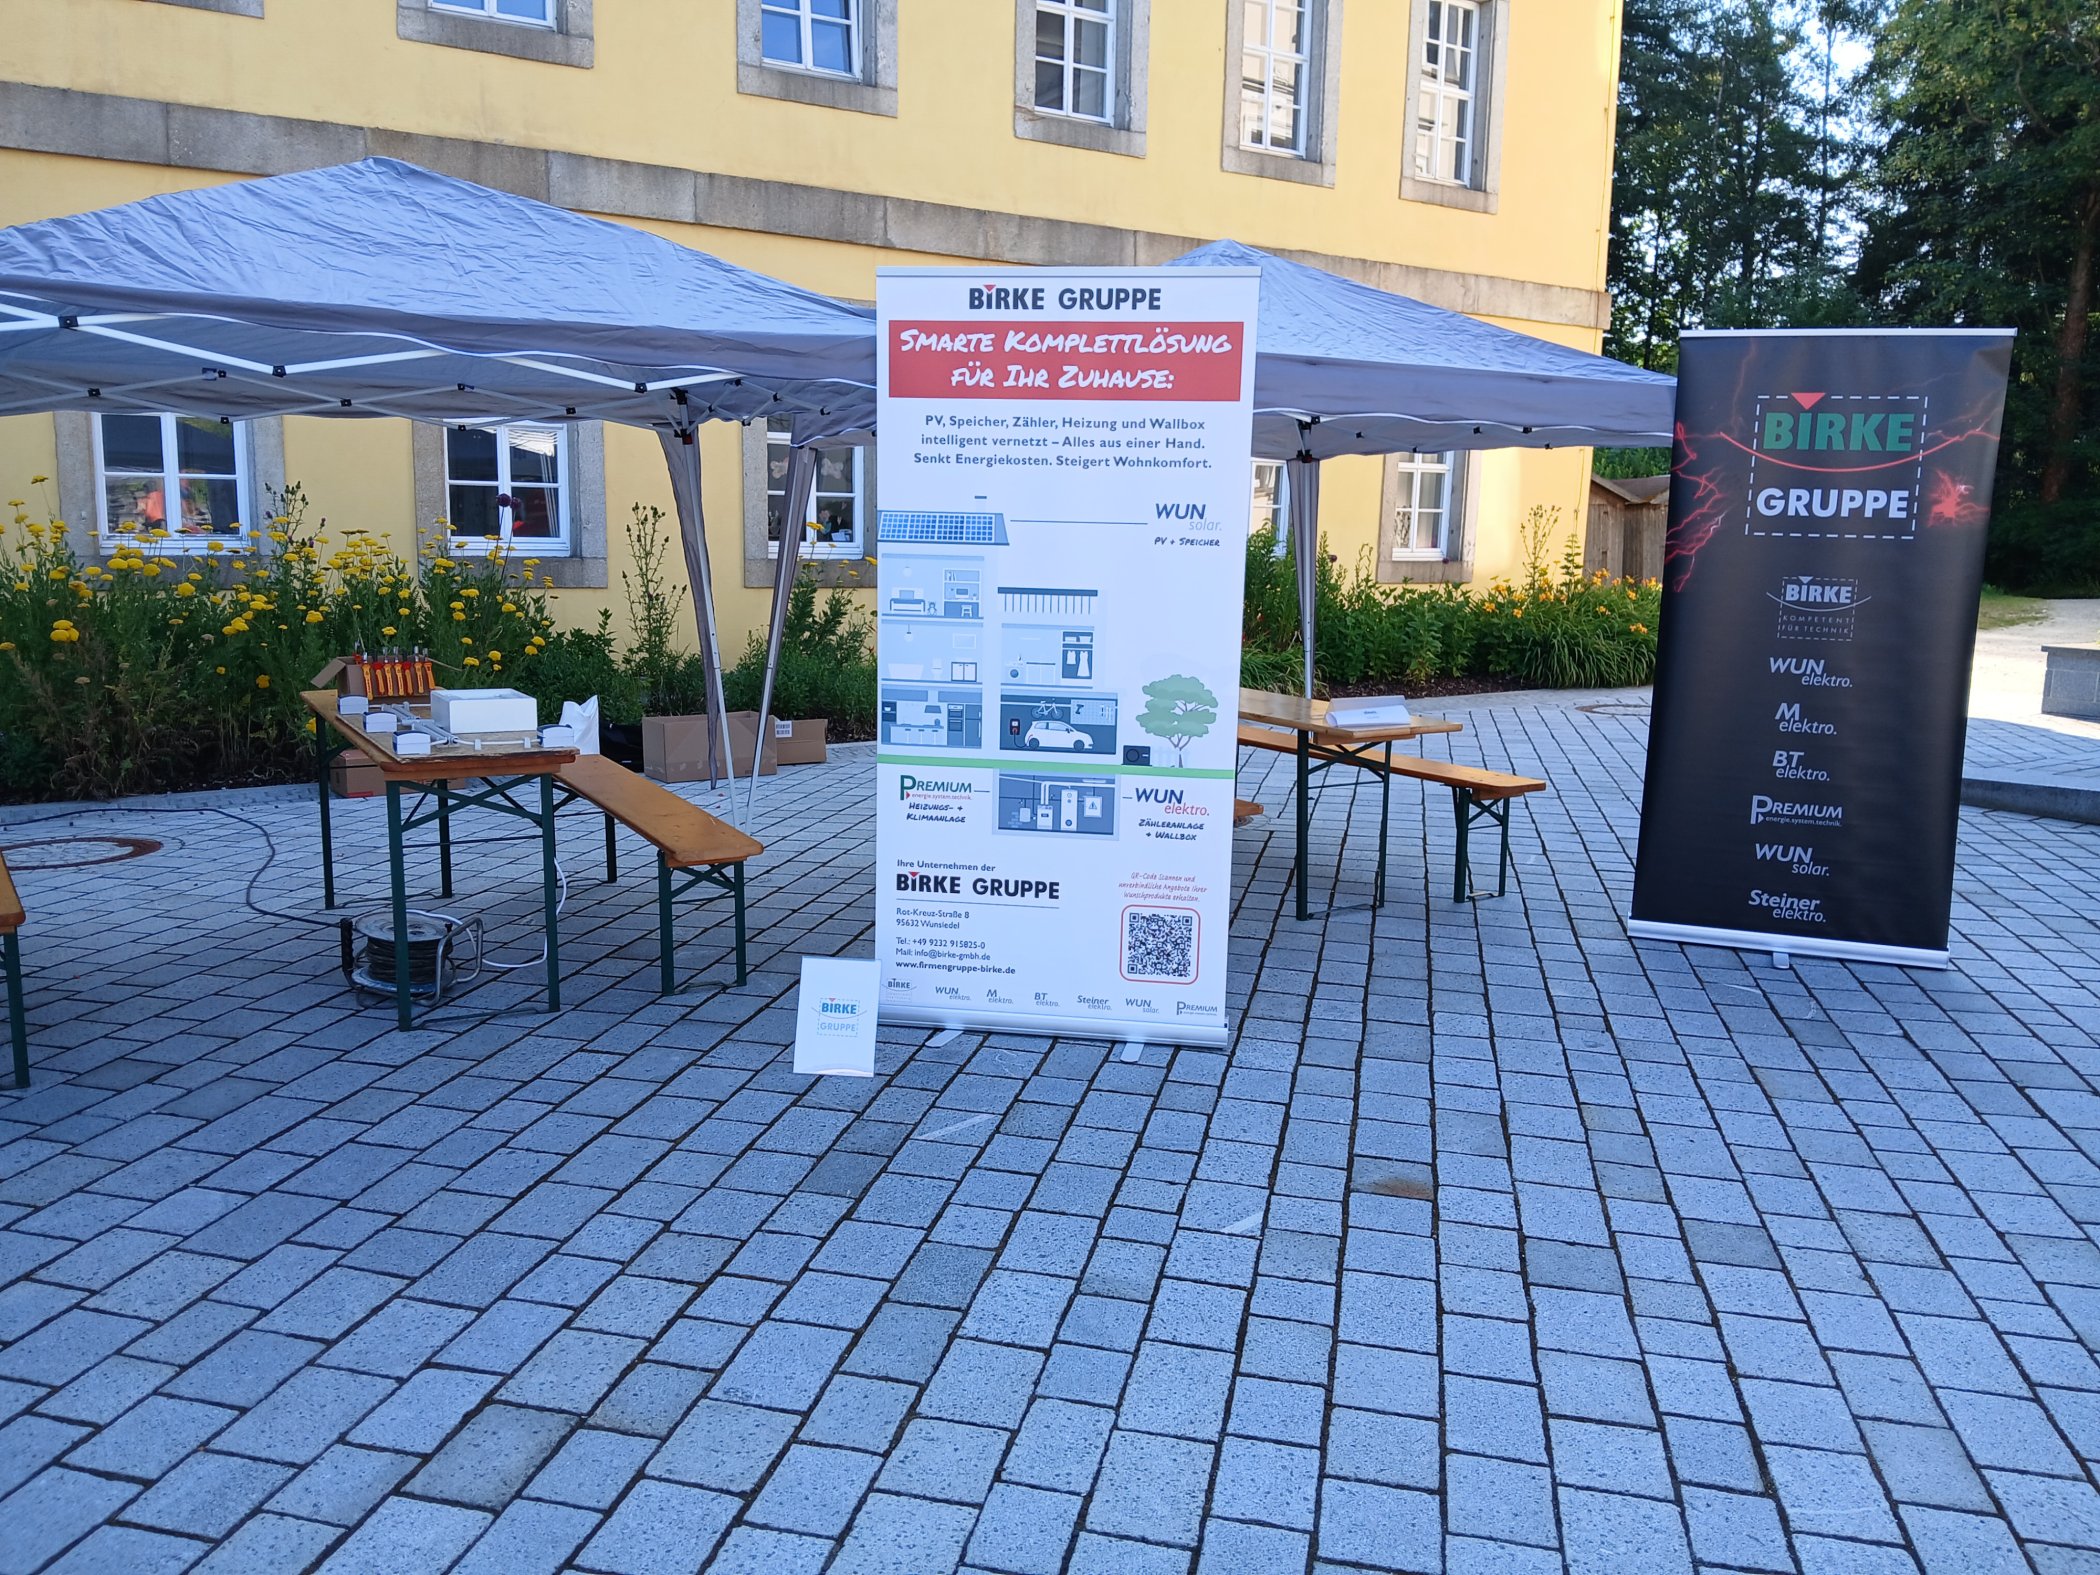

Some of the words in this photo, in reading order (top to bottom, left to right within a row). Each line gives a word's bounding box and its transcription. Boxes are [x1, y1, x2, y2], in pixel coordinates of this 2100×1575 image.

[969, 286, 1045, 310] BIRKE
[1058, 287, 1162, 310] GRUPPE
[925, 415, 946, 428] PV,
[949, 415, 1009, 430] Speicher,
[1012, 415, 1059, 429] Zähler,
[1062, 416, 1117, 431] Heizung
[1122, 418, 1146, 430] und
[1150, 418, 1205, 430] Wallbox
[1763, 412, 1915, 451] BIRKE
[921, 434, 987, 448] intelligent
[992, 436, 1048, 447] vernetzt
[1062, 436, 1095, 448] Alles
[1100, 439, 1121, 449] aus
[1126, 437, 1160, 449] einer
[1166, 437, 1205, 449] Hand.
[914, 452, 951, 464] Senkt
[955, 453, 1052, 467] Energiekosten.
[1056, 455, 1110, 469] Steigert
[1113, 455, 1212, 469] Wohnkomfort.
[1756, 487, 1909, 518] GRUPPE
[1155, 503, 1206, 520] WUN
[1189, 517, 1222, 531] solar.
[1154, 537, 1167, 545] PV
[1785, 584, 1852, 603] BIRKE
[1782, 615, 1850, 623] KOMPETENT
[1804, 626, 1849, 634] TECHNIK
[1769, 657, 1825, 675] WUN
[1801, 672, 1853, 688] elektro.
[1775, 702, 1800, 721] M
[1779, 718, 1837, 735] elektro.
[1772, 750, 1804, 767] BT
[1776, 765, 1830, 781] elektro.
[1135, 787, 1184, 804] WUN
[1164, 802, 1210, 816] elektro.
[1755, 843, 1813, 863] WUN
[896, 859, 915, 868] Ihre
[917, 860, 978, 871] Unternehmen
[981, 863, 996, 872] der
[1792, 861, 1830, 876] solar.
[896, 873, 961, 894] BIRKE
[972, 877, 1060, 900] GRUPPE
[1748, 889, 1820, 911] Steiner
[896, 908, 962, 919] Rot-Kreuz-Straße
[1772, 906, 1826, 922] elektro.
[896, 919, 919, 927] 95632
[920, 920, 960, 929] Wunsiedel
[896, 937, 911, 945] Tel.:
[912, 938, 927, 946] +49
[929, 939, 948, 947] 9232
[950, 940, 986, 949] 915825-0
[895, 948, 913, 956] Mail:
[914, 949, 991, 961] info@birke-gmbh.de
[896, 961, 1016, 975] www.firmengruppe-birke.de
[935, 986, 959, 995] WUN
[986, 989, 997, 998] M
[1034, 992, 1048, 1000] BT
[1077, 995, 1109, 1005] Steiner
[1125, 998, 1151, 1008] WUN
[821, 1003, 857, 1014] BIRKE
[820, 1022, 856, 1032] GRUPPE
